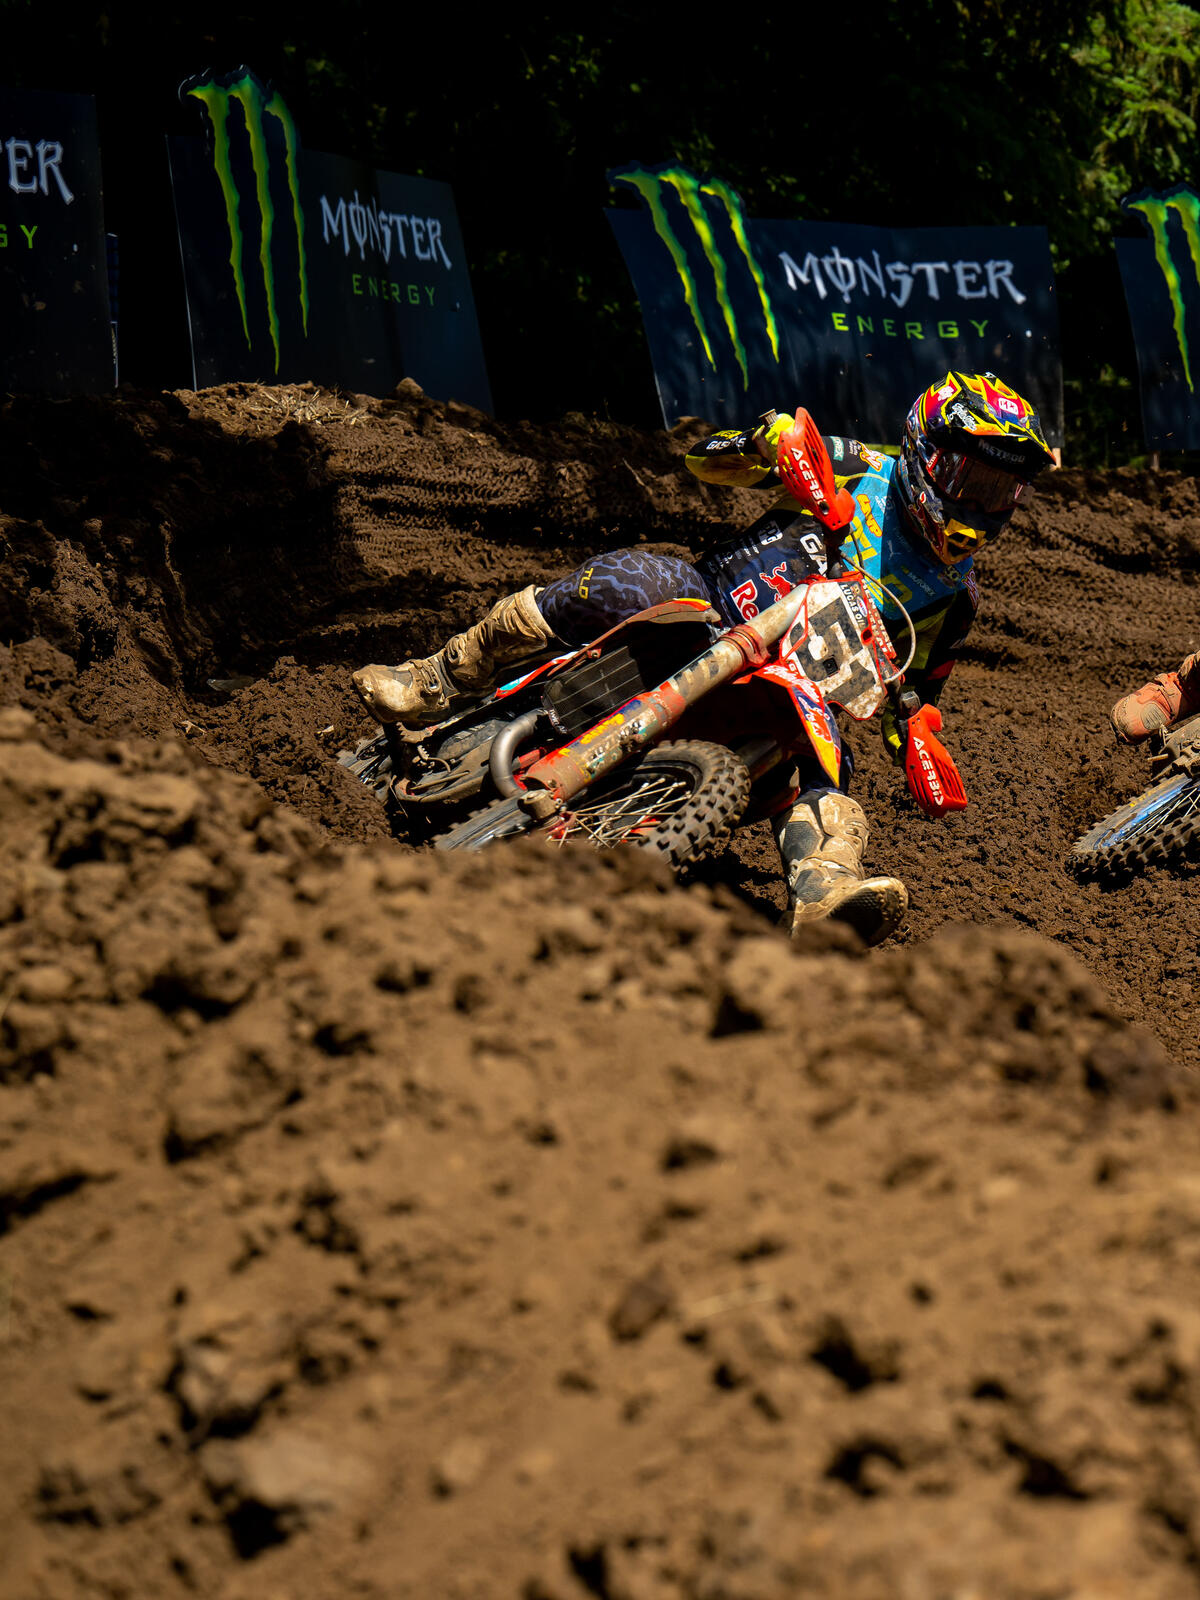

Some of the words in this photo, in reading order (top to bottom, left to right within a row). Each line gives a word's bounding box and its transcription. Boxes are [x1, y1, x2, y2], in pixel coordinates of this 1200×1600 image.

[0, 137, 74, 204] ER
[352, 273, 438, 306] ENERGY
[832, 312, 989, 340] ENERGY
[578, 567, 594, 600] TLD
[840, 583, 859, 615] LUCAS
[789, 596, 876, 705] 51
